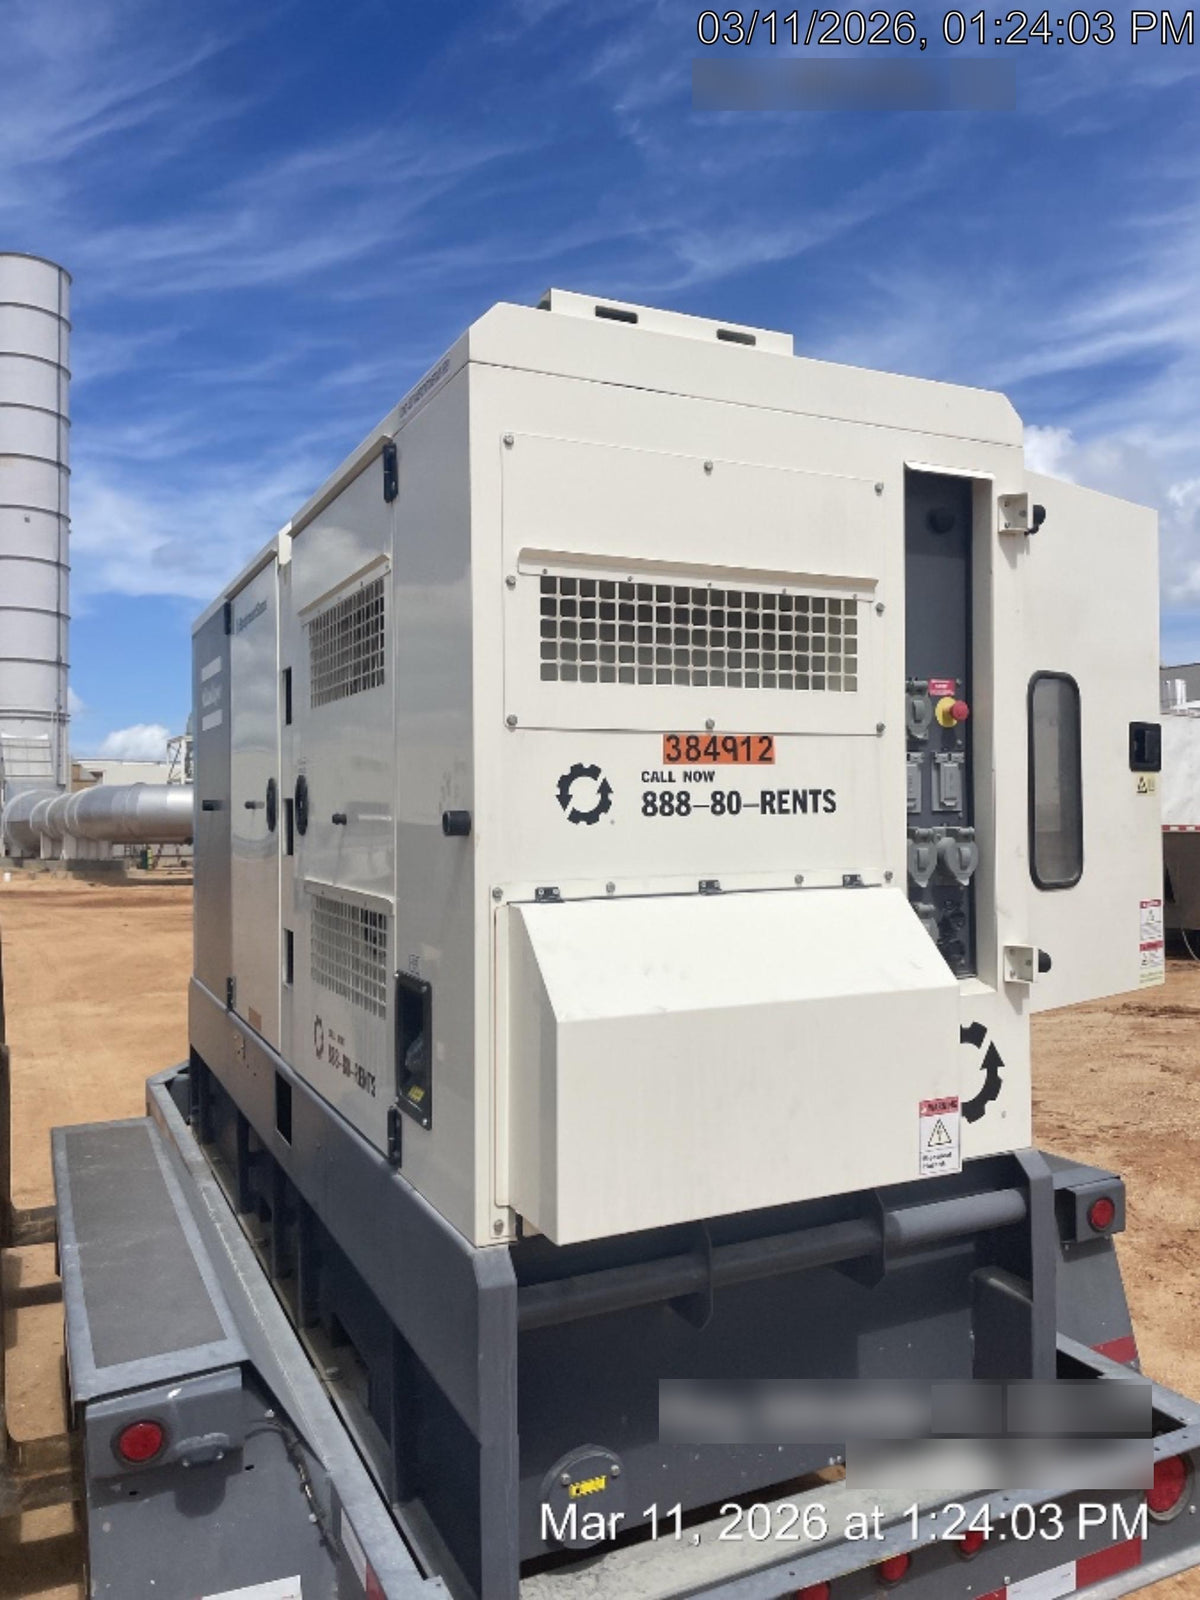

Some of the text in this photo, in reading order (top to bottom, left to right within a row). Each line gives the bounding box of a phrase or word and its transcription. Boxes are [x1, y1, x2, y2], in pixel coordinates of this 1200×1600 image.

[665, 734, 773, 762] 384912
[641, 770, 715, 783] CALL NOW
[641, 788, 837, 817] 888-80-RENTS
